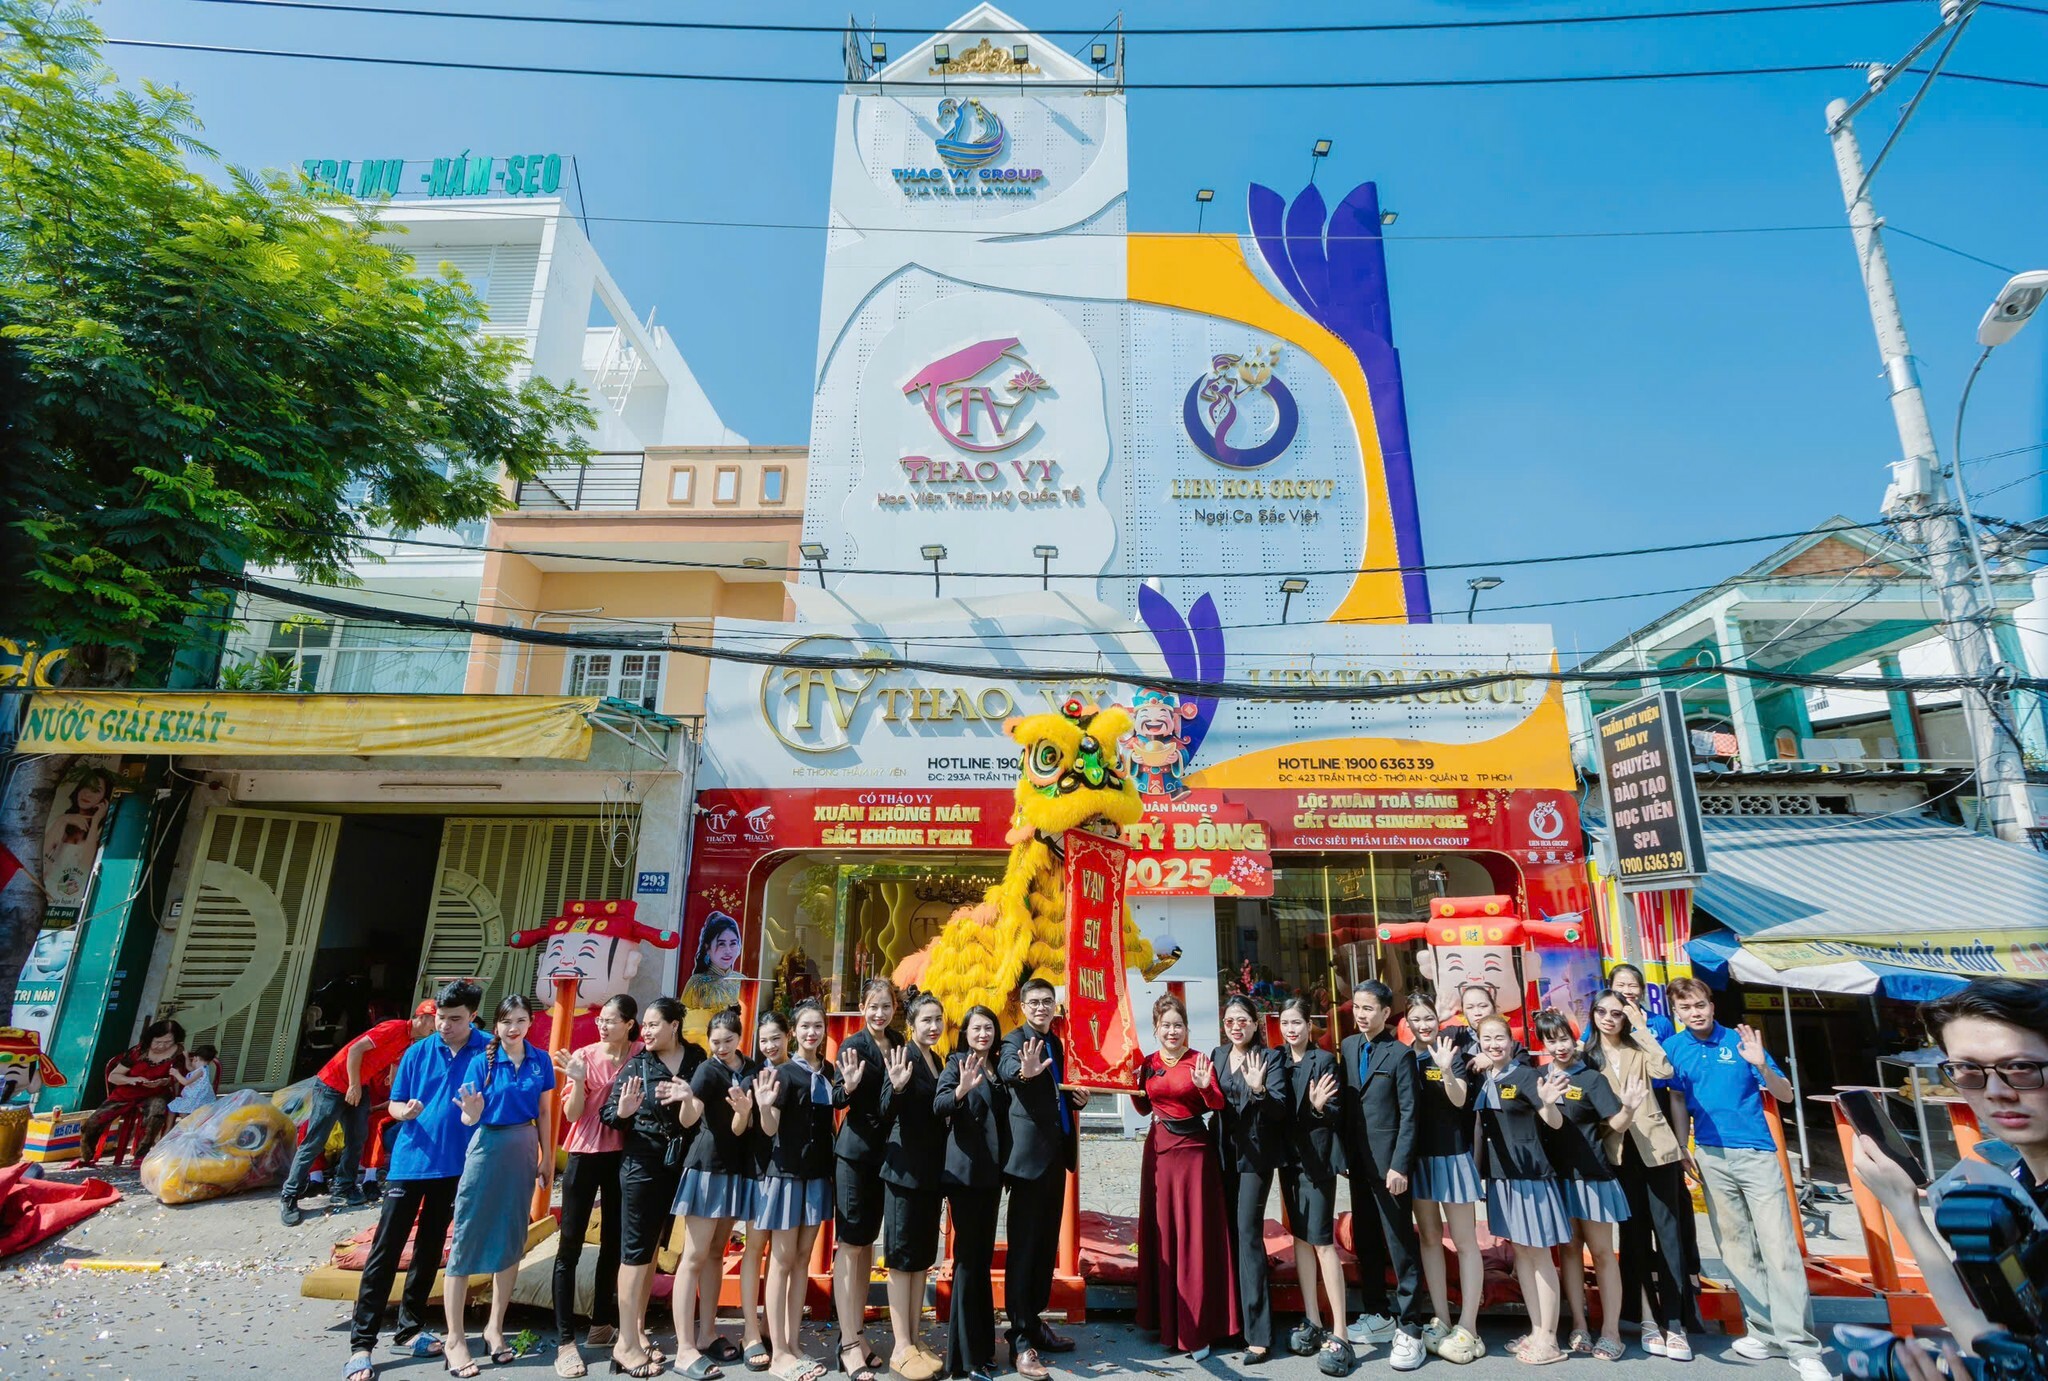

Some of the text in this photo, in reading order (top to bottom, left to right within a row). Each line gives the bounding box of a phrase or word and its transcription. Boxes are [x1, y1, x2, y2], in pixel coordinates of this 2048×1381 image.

[892, 168, 1043, 183] THAO VY GROUP
[899, 456, 1058, 484] THAO VY
[1171, 479, 1335, 499] LIEN HOA GROUP
[1233, 509, 1253, 523] Ca
[877, 687, 1014, 721] THAO
[23, 700, 96, 742] NƯỚC
[97, 695, 155, 743] GIẢI
[152, 701, 227, 743] KHÁT
[1637, 730, 1648, 745] VY
[996, 757, 1019, 769] 190
[1345, 758, 1378, 770] 1900
[1380, 758, 1415, 770] 6363
[1417, 758, 1435, 770] 39
[1611, 750, 1662, 779] CHUYÊN
[947, 773, 971, 781] 293A
[1298, 774, 1316, 782] 423
[1409, 774, 1423, 782] AN
[1460, 774, 1469, 782] 12
[1476, 774, 1489, 782] TP
[1491, 774, 1513, 782] HCM
[916, 793, 934, 804] VY
[1613, 775, 1667, 804] ĐÀO TẠO
[1143, 801, 1218, 813] UÂN MÙNG 9
[1330, 793, 1376, 809] XUÂN
[813, 803, 866, 822] XUÂN
[868, 803, 931, 822] KHÔNG
[1375, 814, 1469, 829] SINGAPORE
[1614, 809, 1640, 830] HỌC
[860, 825, 924, 845] KHÔNG
[927, 829, 973, 845] PHAI
[1172, 813, 1267, 851] ĐỒNG
[1294, 836, 1323, 846] CÙNG
[1325, 835, 1348, 846] SIÊU
[1383, 835, 1407, 846] LIÊN
[1409, 837, 1431, 846] HOA
[1433, 837, 1470, 846] GROUP
[1633, 829, 1661, 850] SPA
[1620, 850, 1684, 875] 1900 6363 39
[641, 874, 666, 887] 293
[1124, 857, 1213, 888] 2025
[1081, 868, 1106, 907] VẠN
[14, 986, 57, 1004] TRỊ NÁM
[1088, 1013, 1101, 1052] Ý
